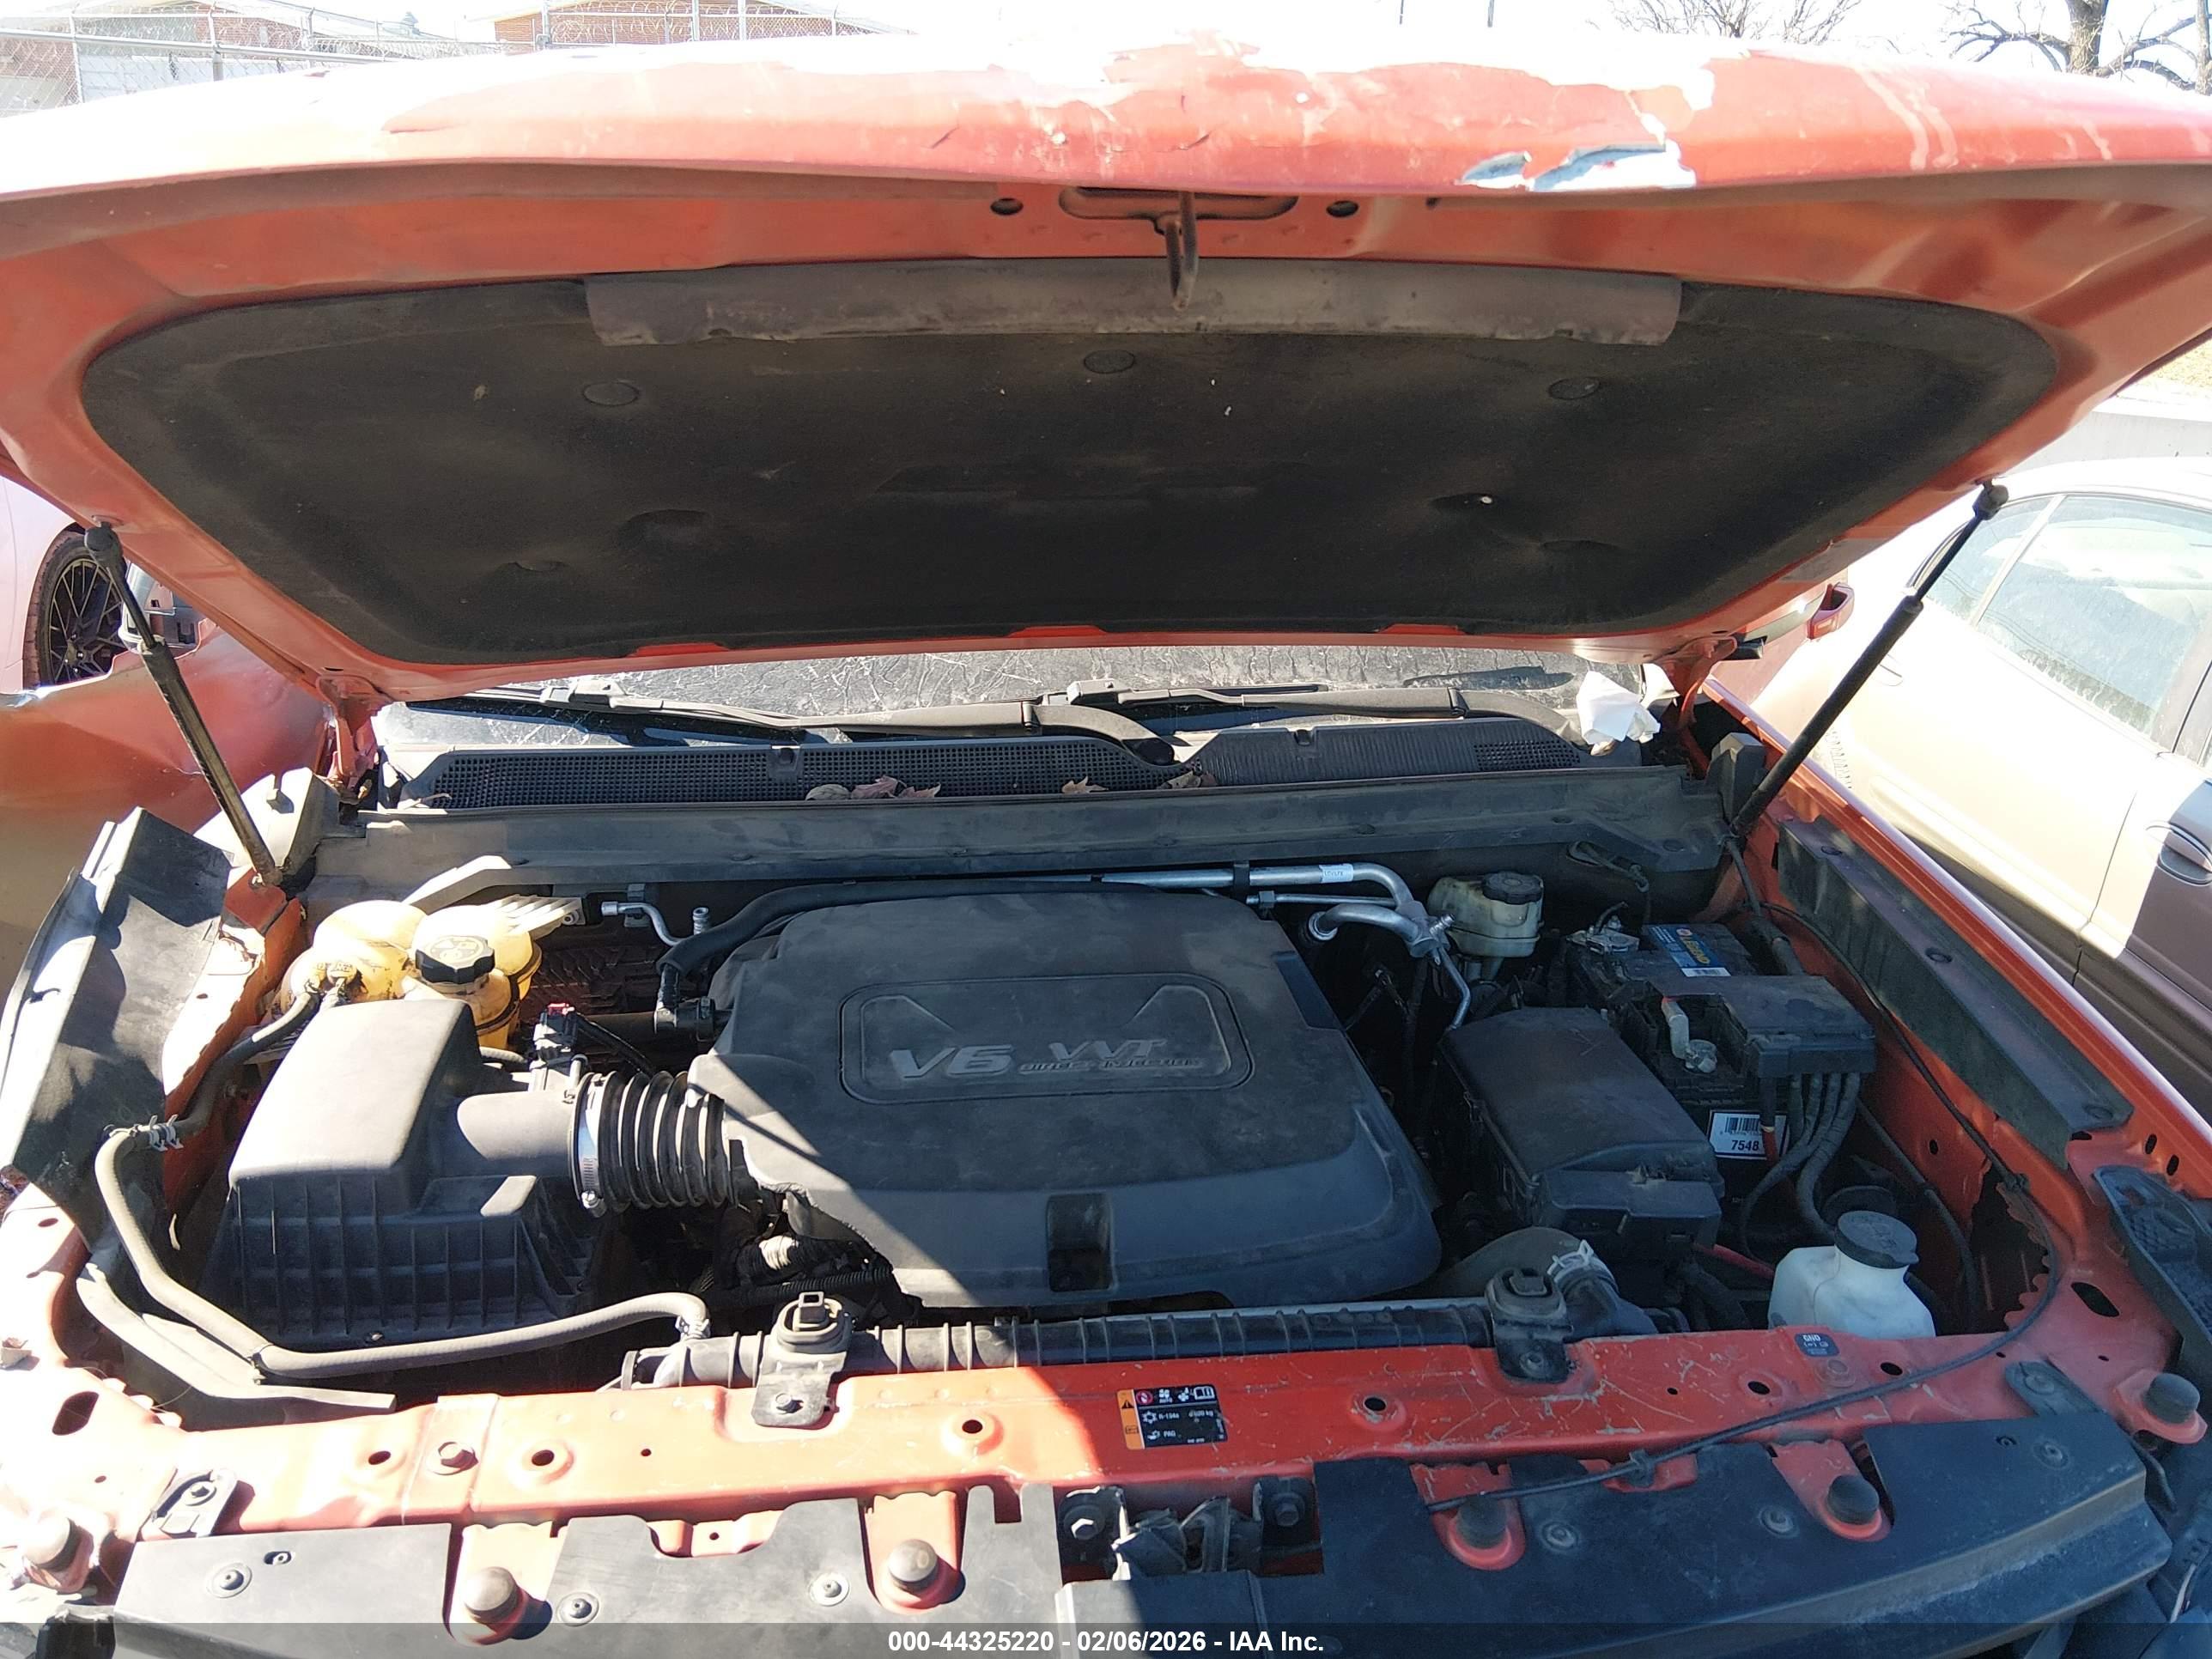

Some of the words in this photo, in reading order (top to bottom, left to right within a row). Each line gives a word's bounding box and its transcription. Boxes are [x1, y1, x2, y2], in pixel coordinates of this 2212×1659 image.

[1048, 1038, 1168, 1060] VVT
[890, 1043, 1015, 1079] V6
[1730, 1139, 1759, 1152] 7548
